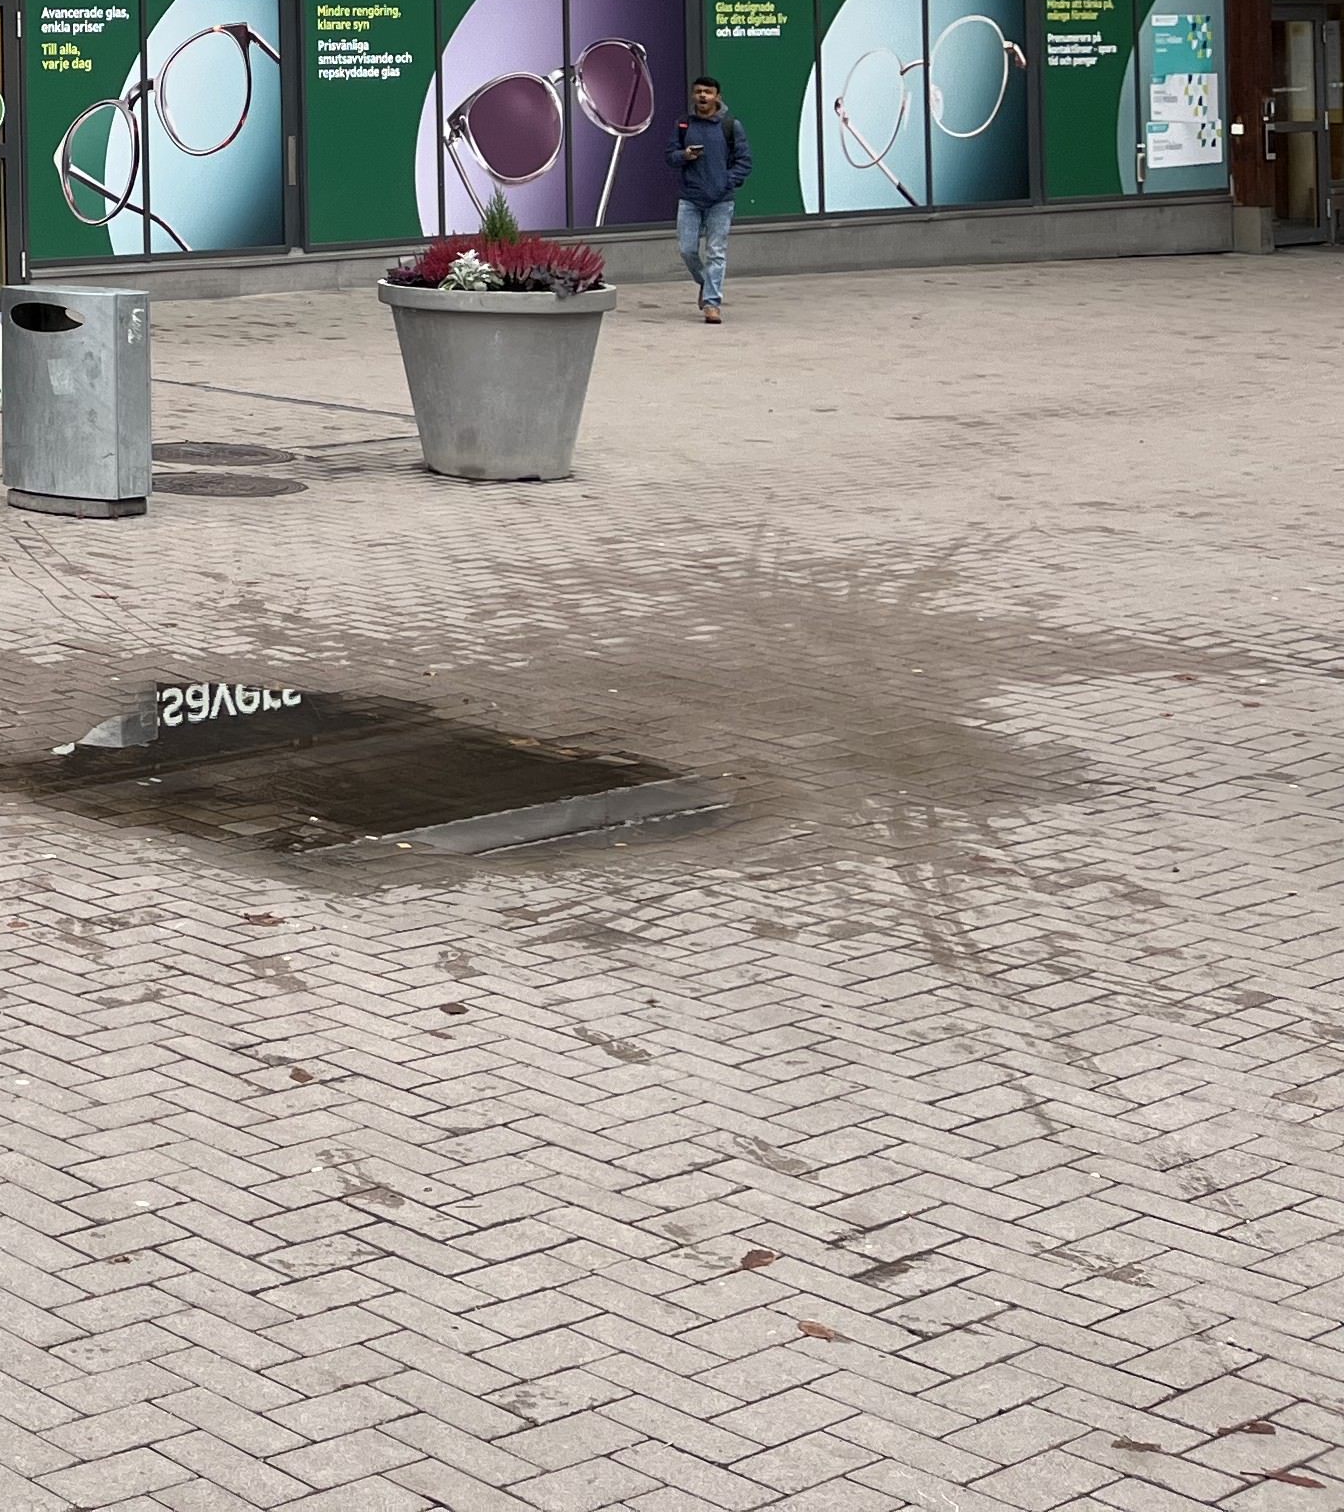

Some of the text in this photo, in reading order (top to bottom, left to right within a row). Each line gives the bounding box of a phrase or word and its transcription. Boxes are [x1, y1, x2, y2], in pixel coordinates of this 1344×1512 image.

[41, 5, 130, 21] Avancerade glas,
[317, 4, 402, 19] Mindre rengöring,
[41, 19, 105, 36] enkla priser
[317, 18, 370, 32] klarare syn
[41, 42, 81, 57] Till alla,
[317, 38, 370, 52] Prisvänliga
[41, 57, 92, 73] varje dag
[395, 52, 412, 64] och
[381, 66, 401, 80] glas
